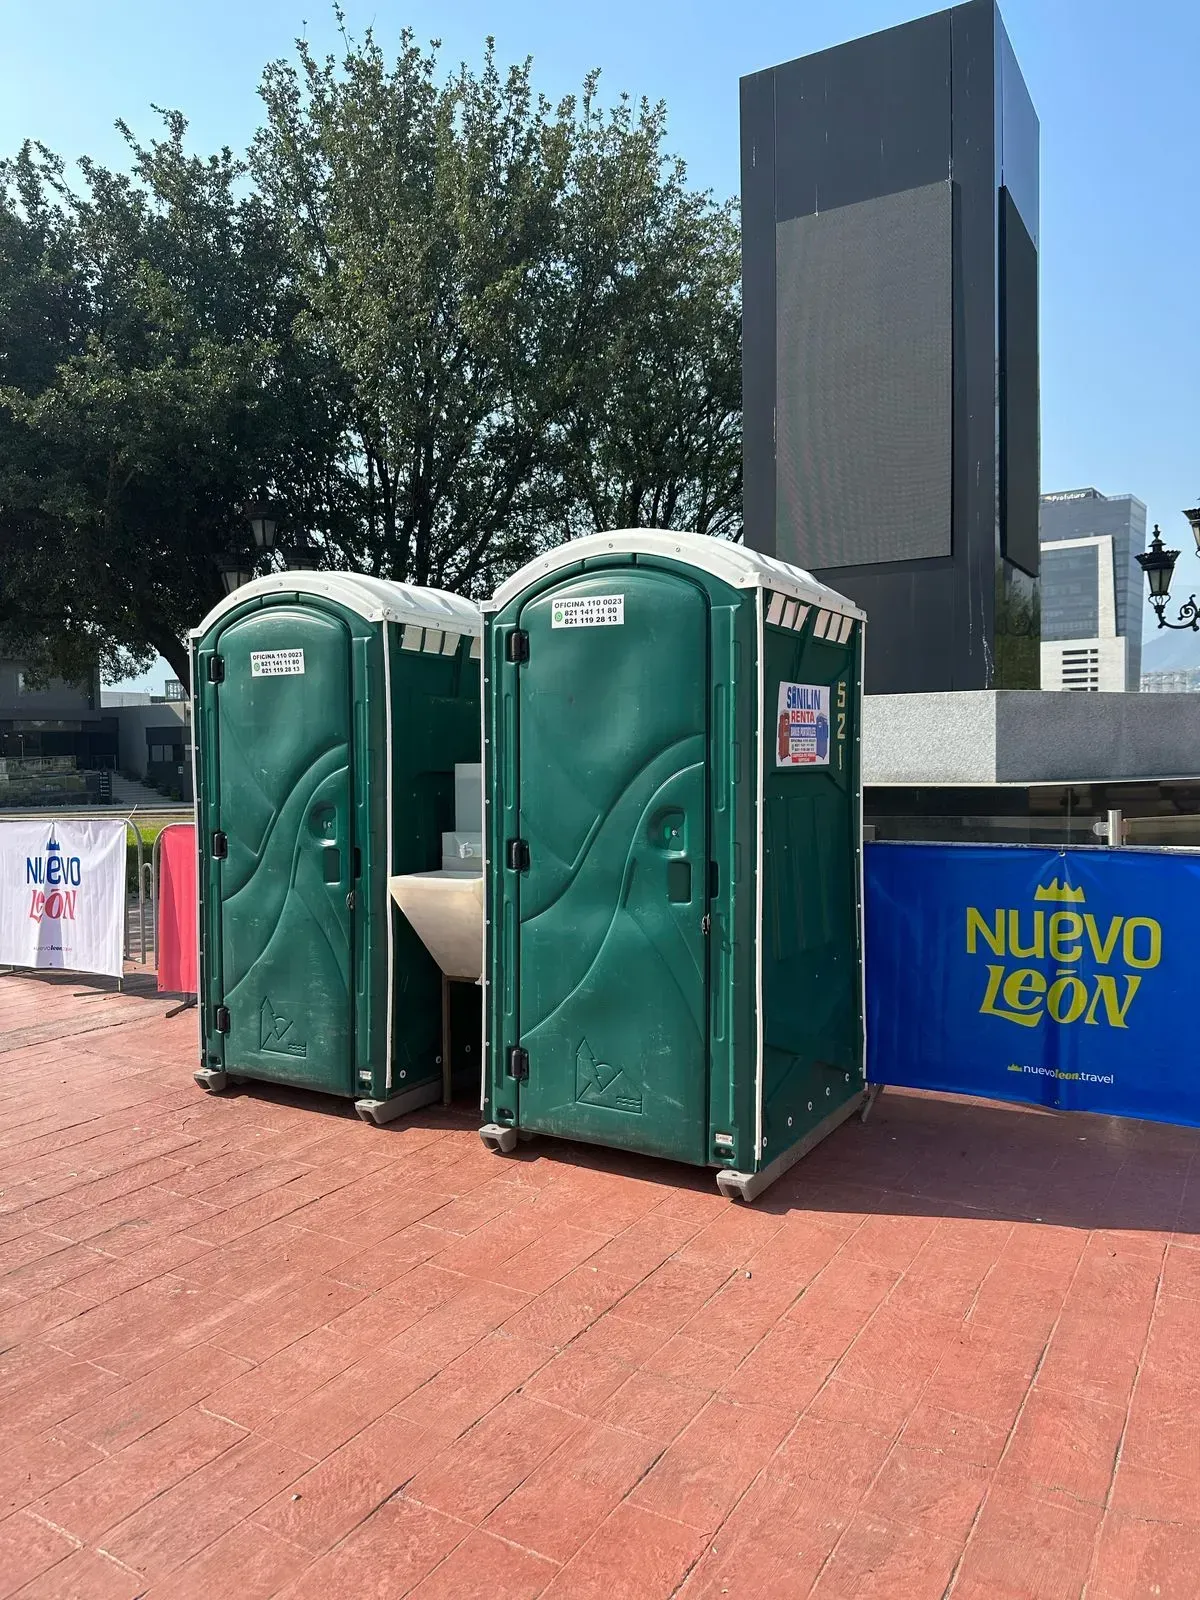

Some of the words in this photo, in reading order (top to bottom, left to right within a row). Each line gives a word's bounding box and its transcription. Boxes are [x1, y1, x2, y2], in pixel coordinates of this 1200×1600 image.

[555, 601, 585, 609] OFICINA
[791, 710, 815, 723] RENTA
[1023, 1065, 1114, 1084] nuevoleon.travel
